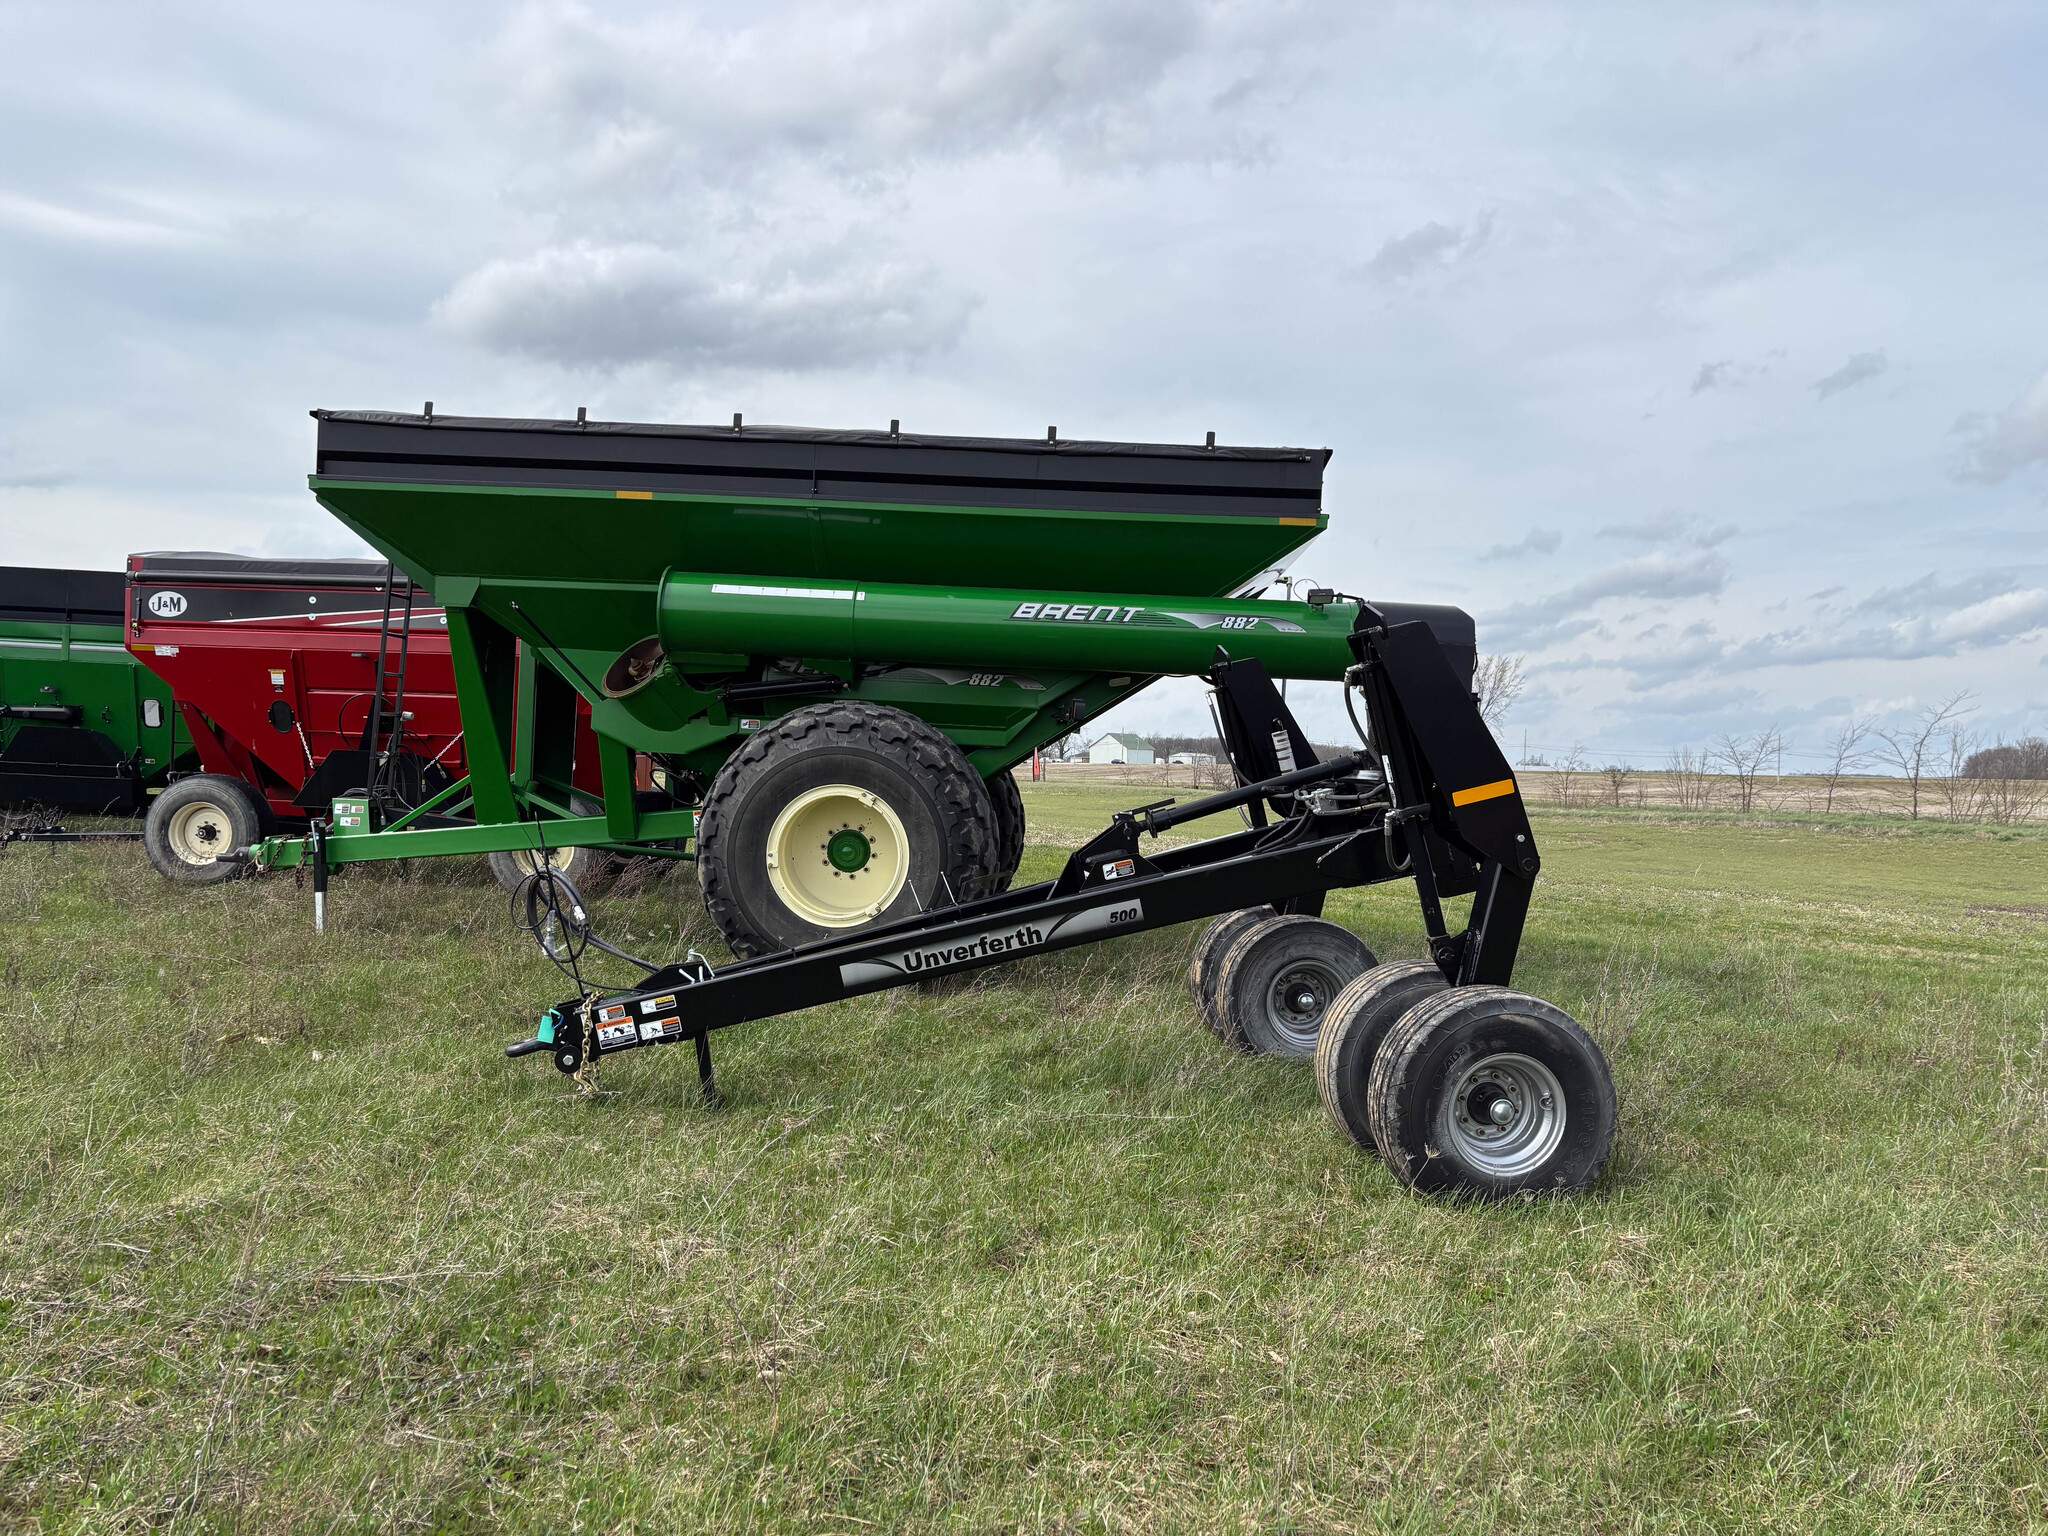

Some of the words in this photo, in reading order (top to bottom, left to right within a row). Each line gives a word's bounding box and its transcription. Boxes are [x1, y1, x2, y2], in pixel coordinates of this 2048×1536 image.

[151, 596, 182, 613] J&M
[1012, 602, 1146, 623] BRENT
[1221, 616, 1260, 630] 882
[968, 673, 1004, 687] 882
[1109, 908, 1138, 924] 500
[903, 926, 1043, 972] Unverferth
